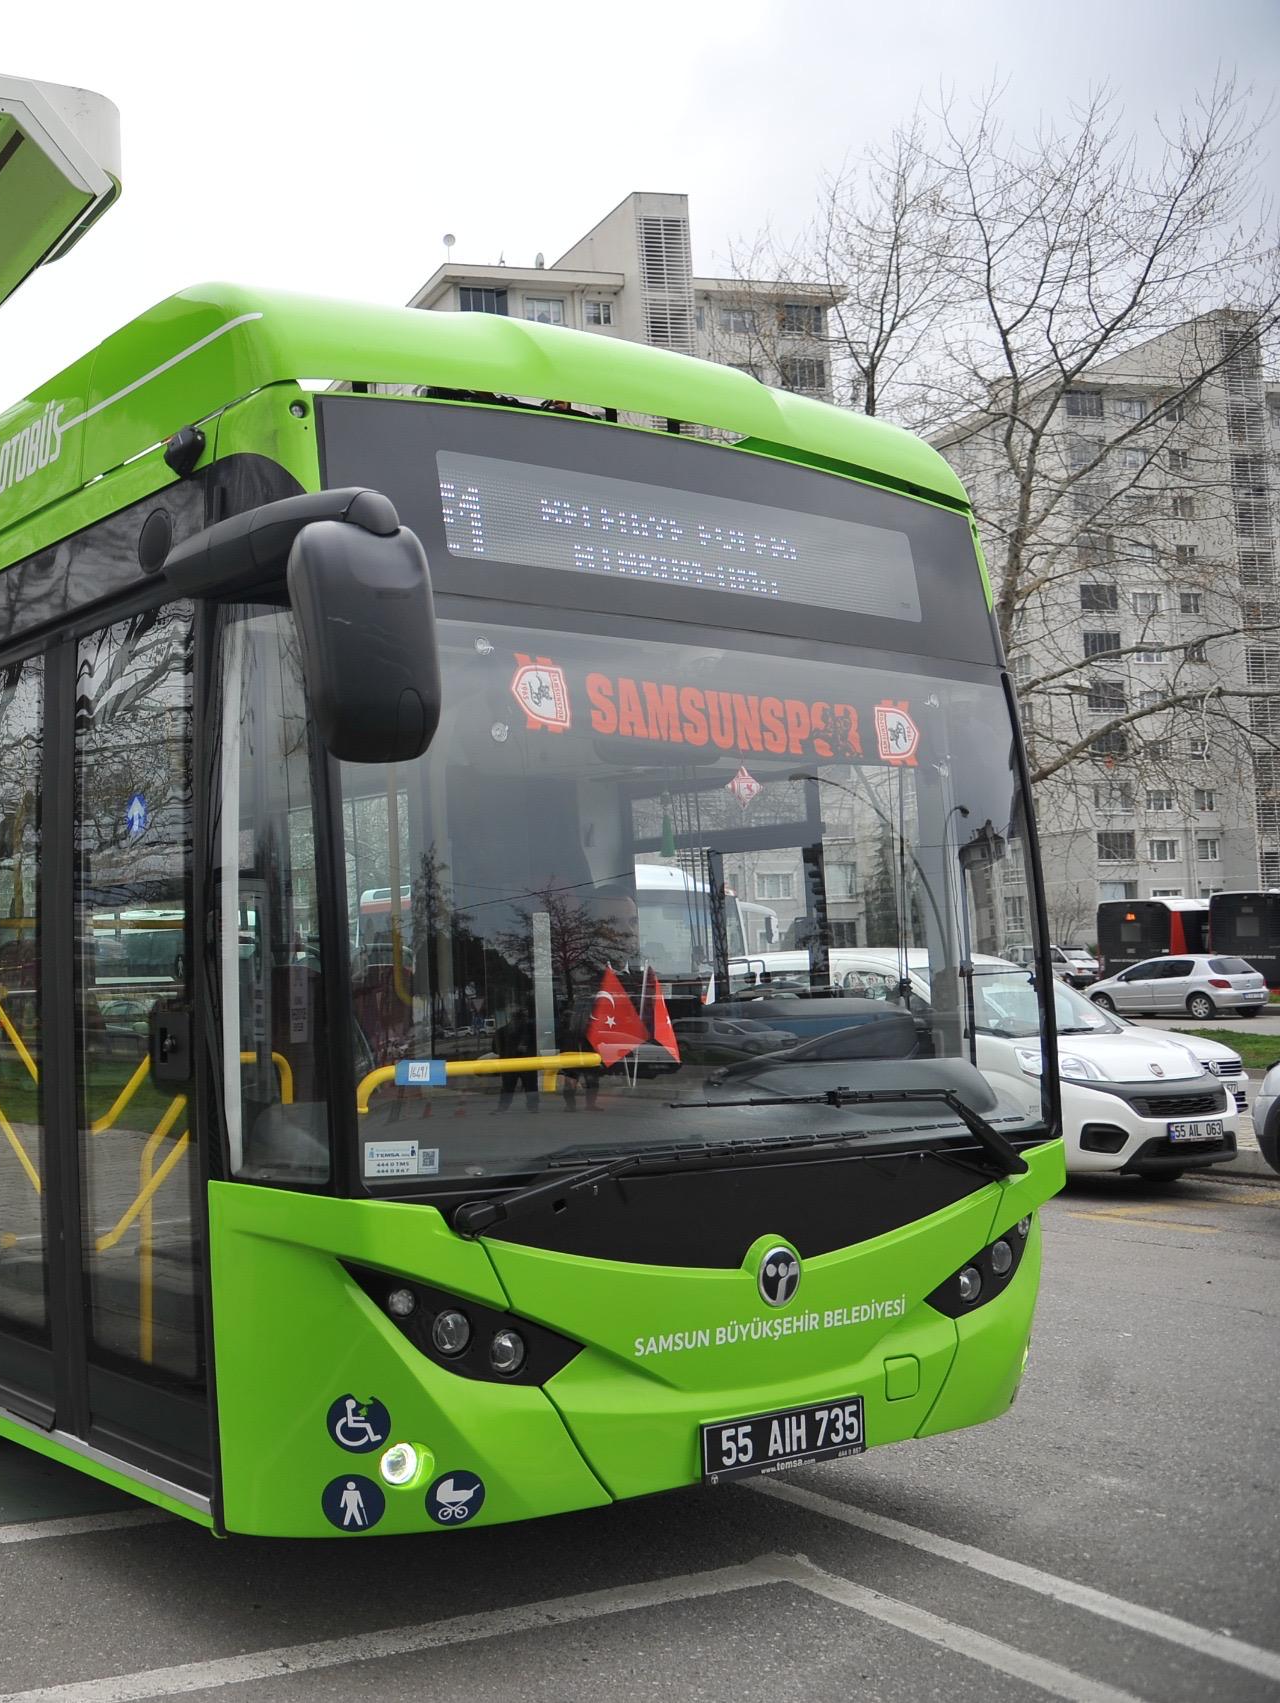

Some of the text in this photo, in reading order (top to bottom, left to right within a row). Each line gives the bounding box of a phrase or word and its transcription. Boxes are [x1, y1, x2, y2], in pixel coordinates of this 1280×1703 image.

[1174, 1125, 1187, 1138] 55
[1205, 1122, 1222, 1136] 063
[634, 1294, 907, 1358] SAMSUN BÜYÜKŞEHİR BELEDİYESİ
[721, 1404, 859, 1467] 55 AIH 735
